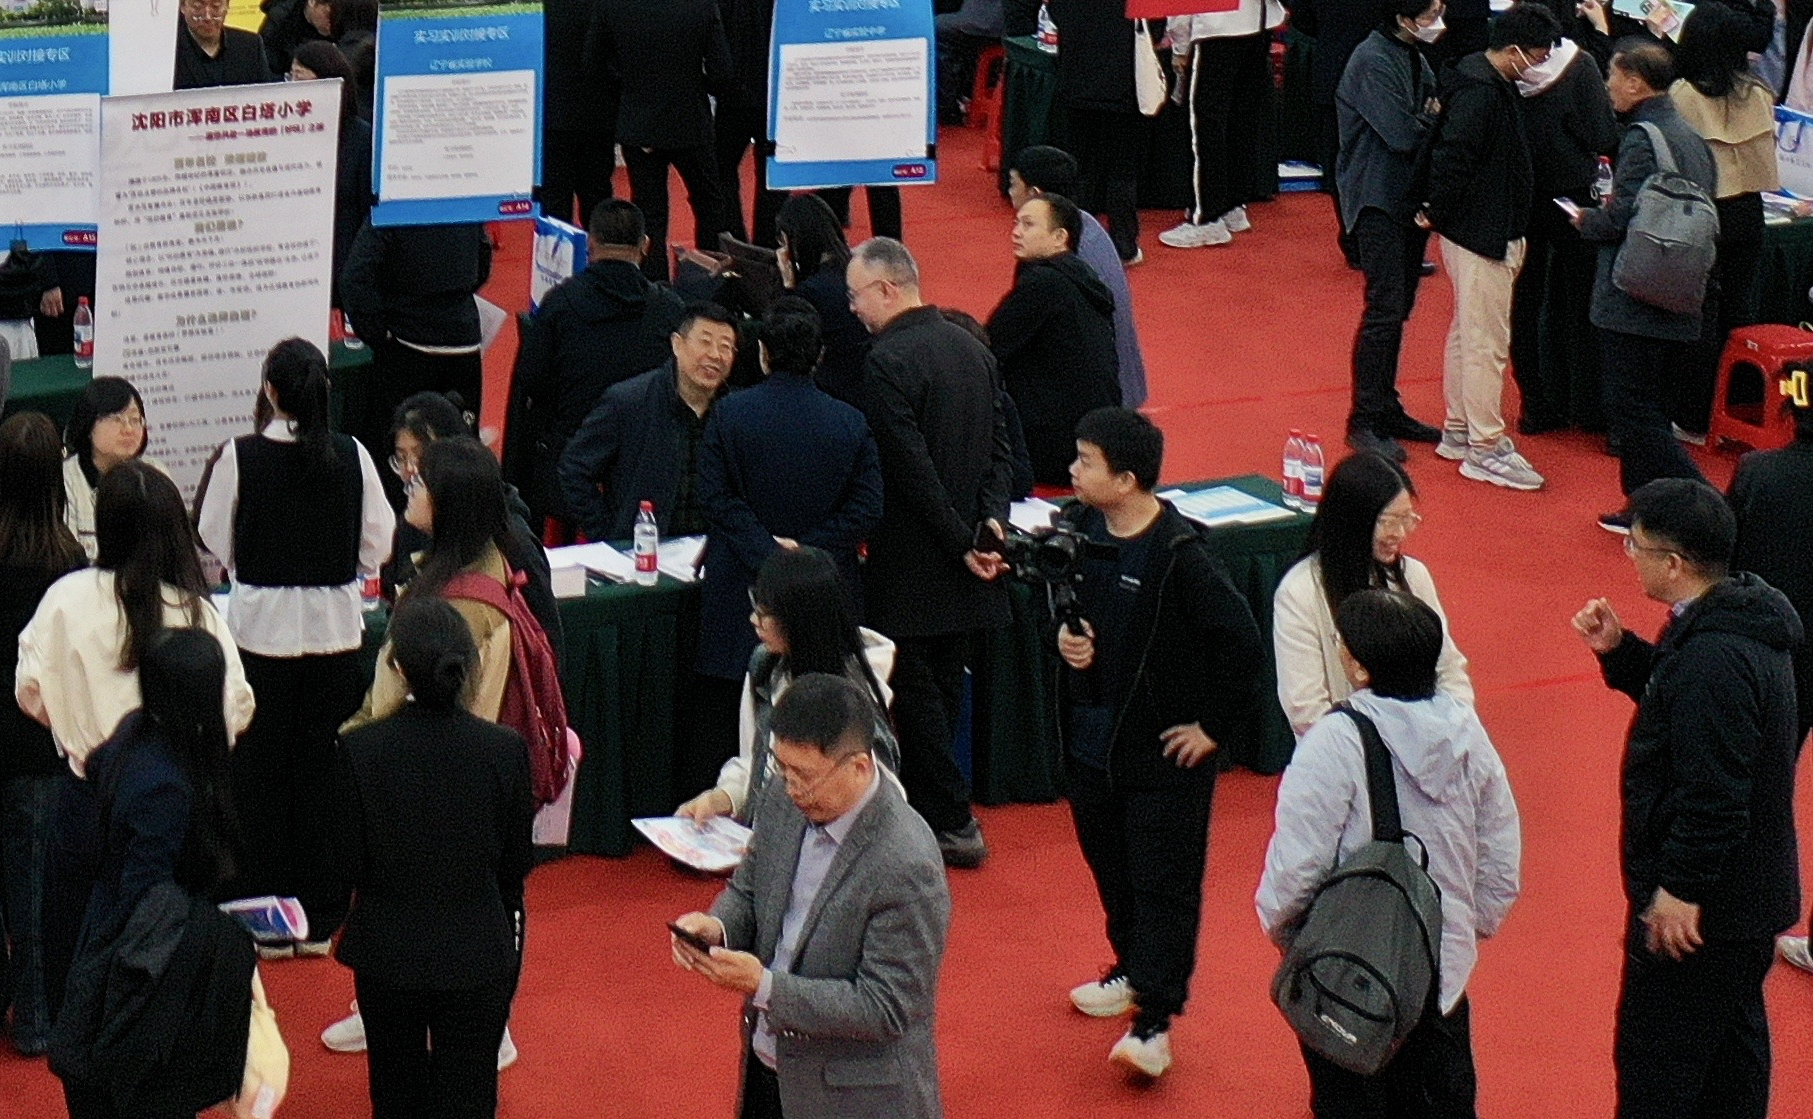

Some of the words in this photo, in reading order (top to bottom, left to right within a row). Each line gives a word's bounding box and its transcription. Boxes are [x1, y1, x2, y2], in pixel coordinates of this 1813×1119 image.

[131, 99, 313, 131] 沈阳市浑南区白塔小学
